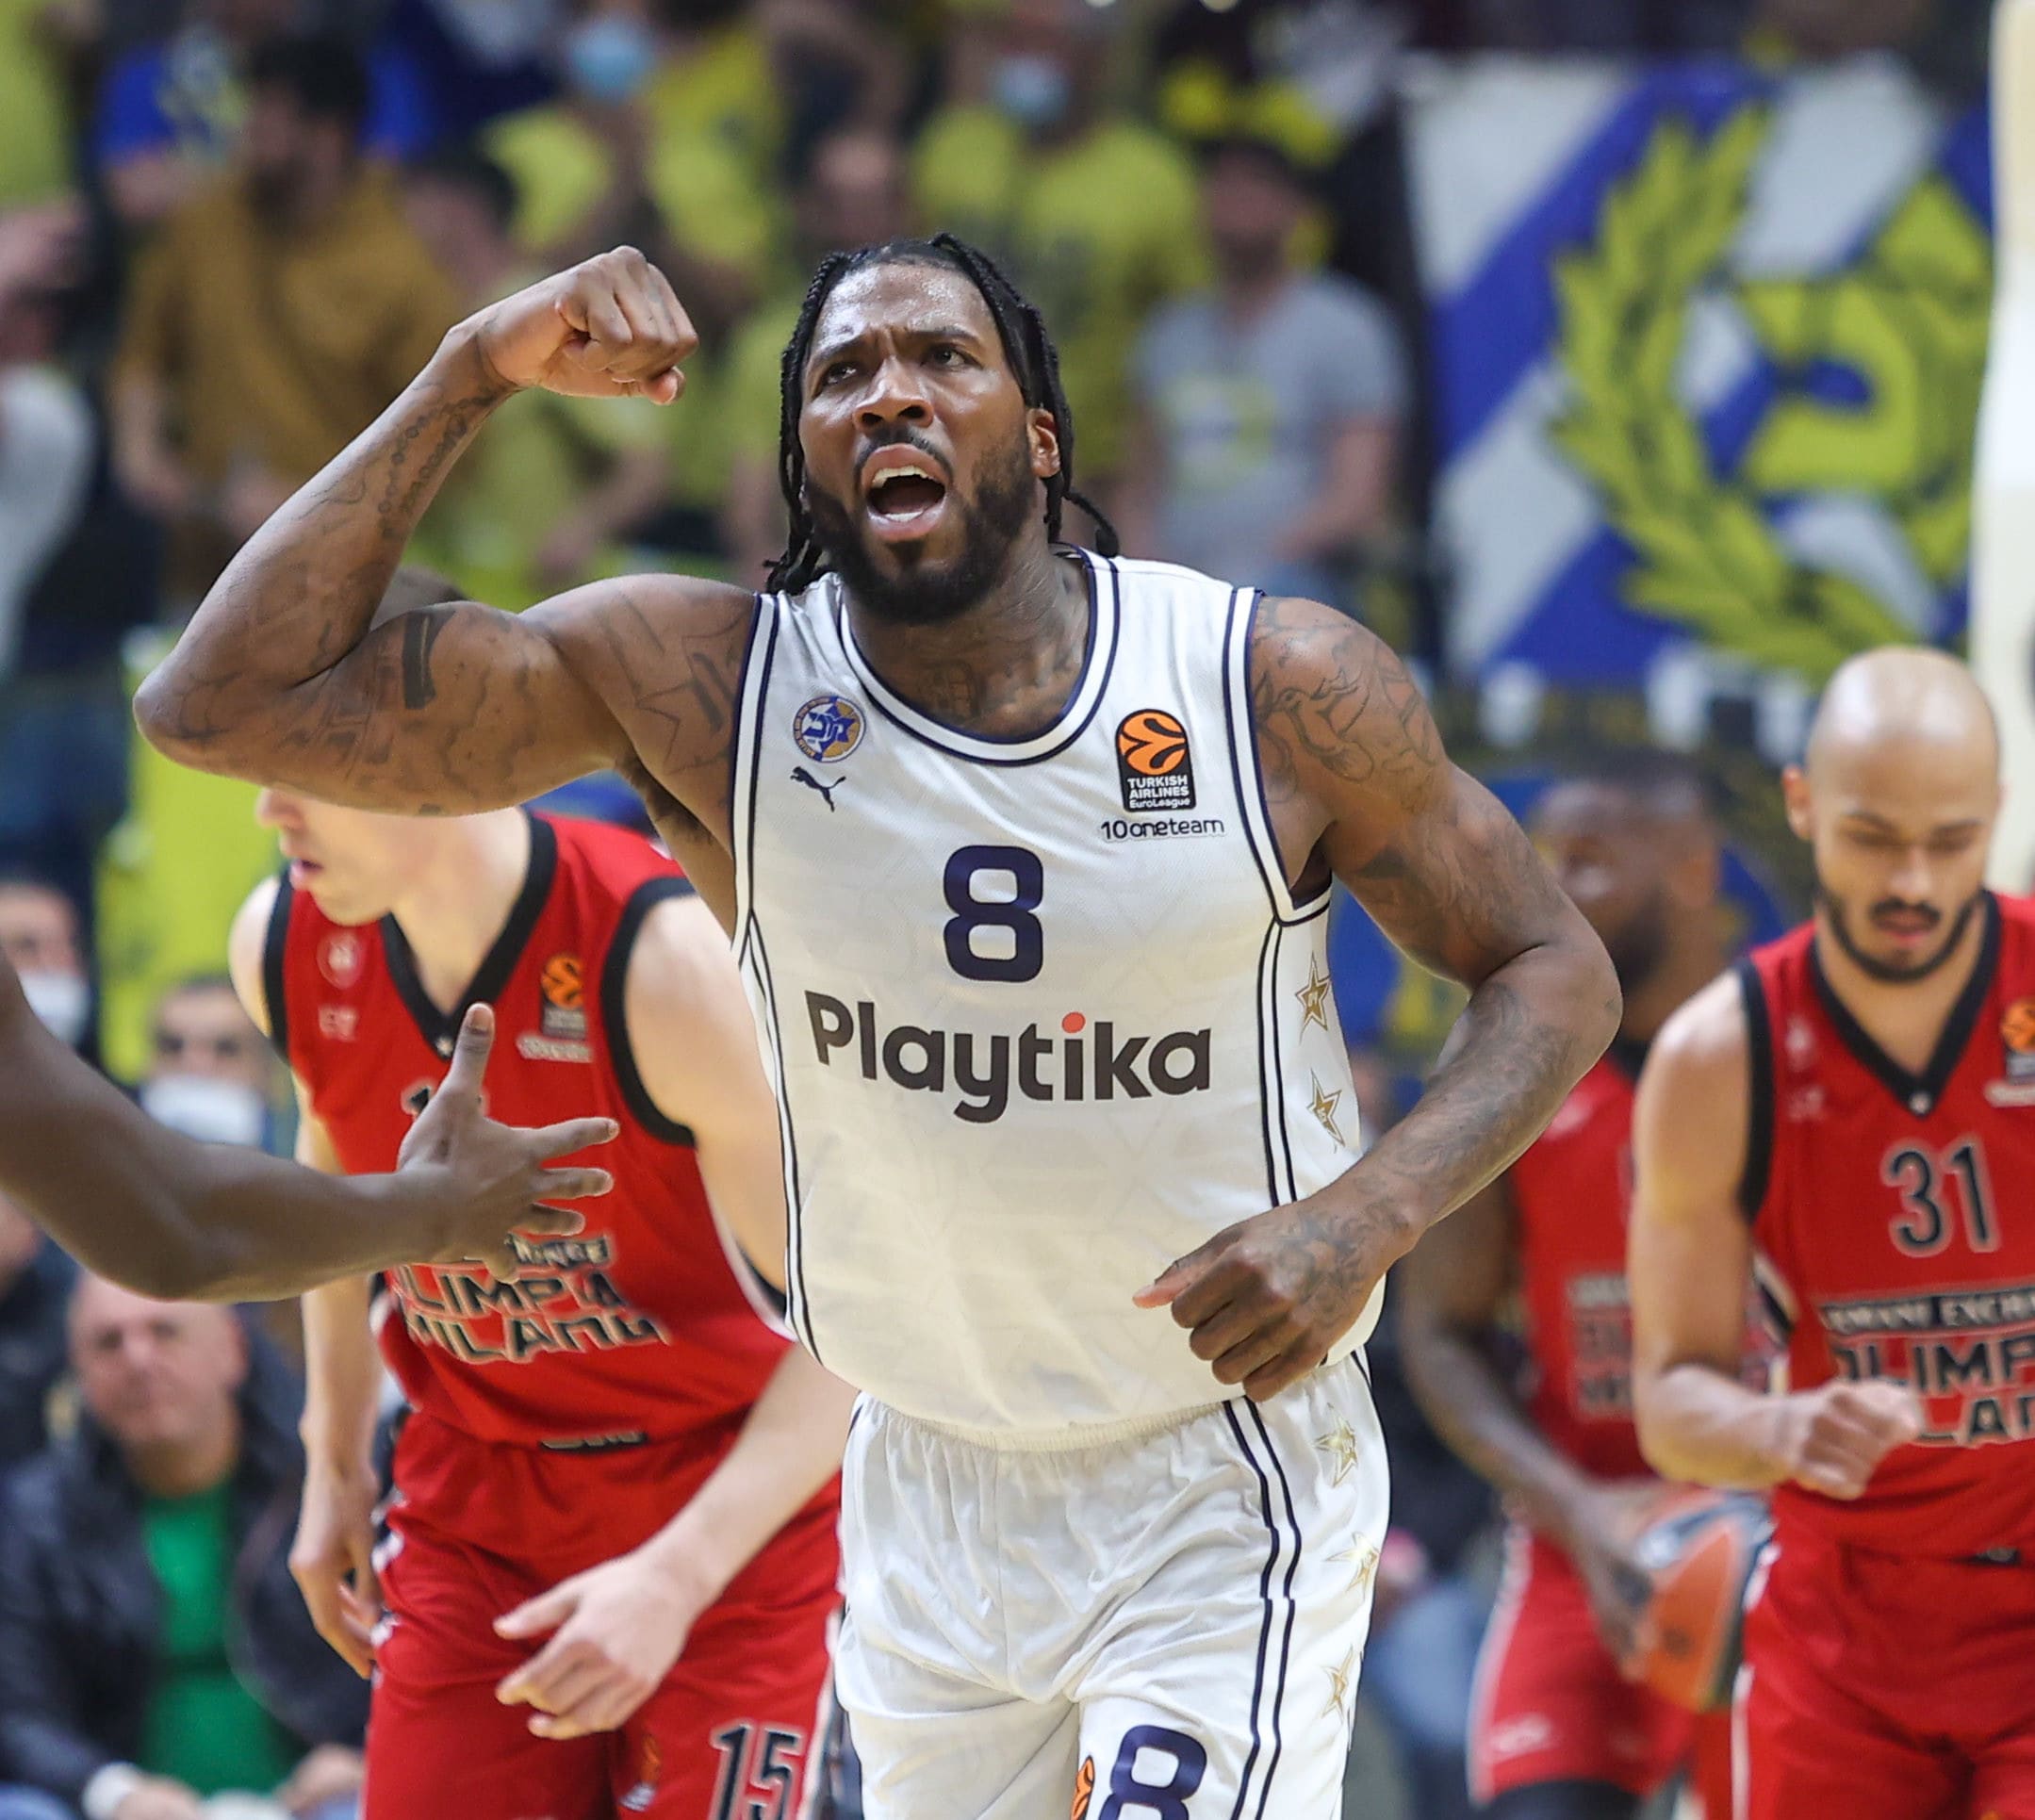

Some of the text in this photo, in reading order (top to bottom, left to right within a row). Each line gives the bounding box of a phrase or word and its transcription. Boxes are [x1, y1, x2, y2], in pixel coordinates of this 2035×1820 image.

[1127, 775, 1188, 789] TURKISH
[1129, 786, 1190, 799] AIRLINES
[1129, 797, 1190, 809] EuroLeague
[944, 845, 1043, 982] 8
[805, 991, 1211, 1123] Playtika
[1881, 1137, 1998, 1259] 31
[710, 1719, 804, 1820] 15
[1098, 1724, 1206, 1820] 8
